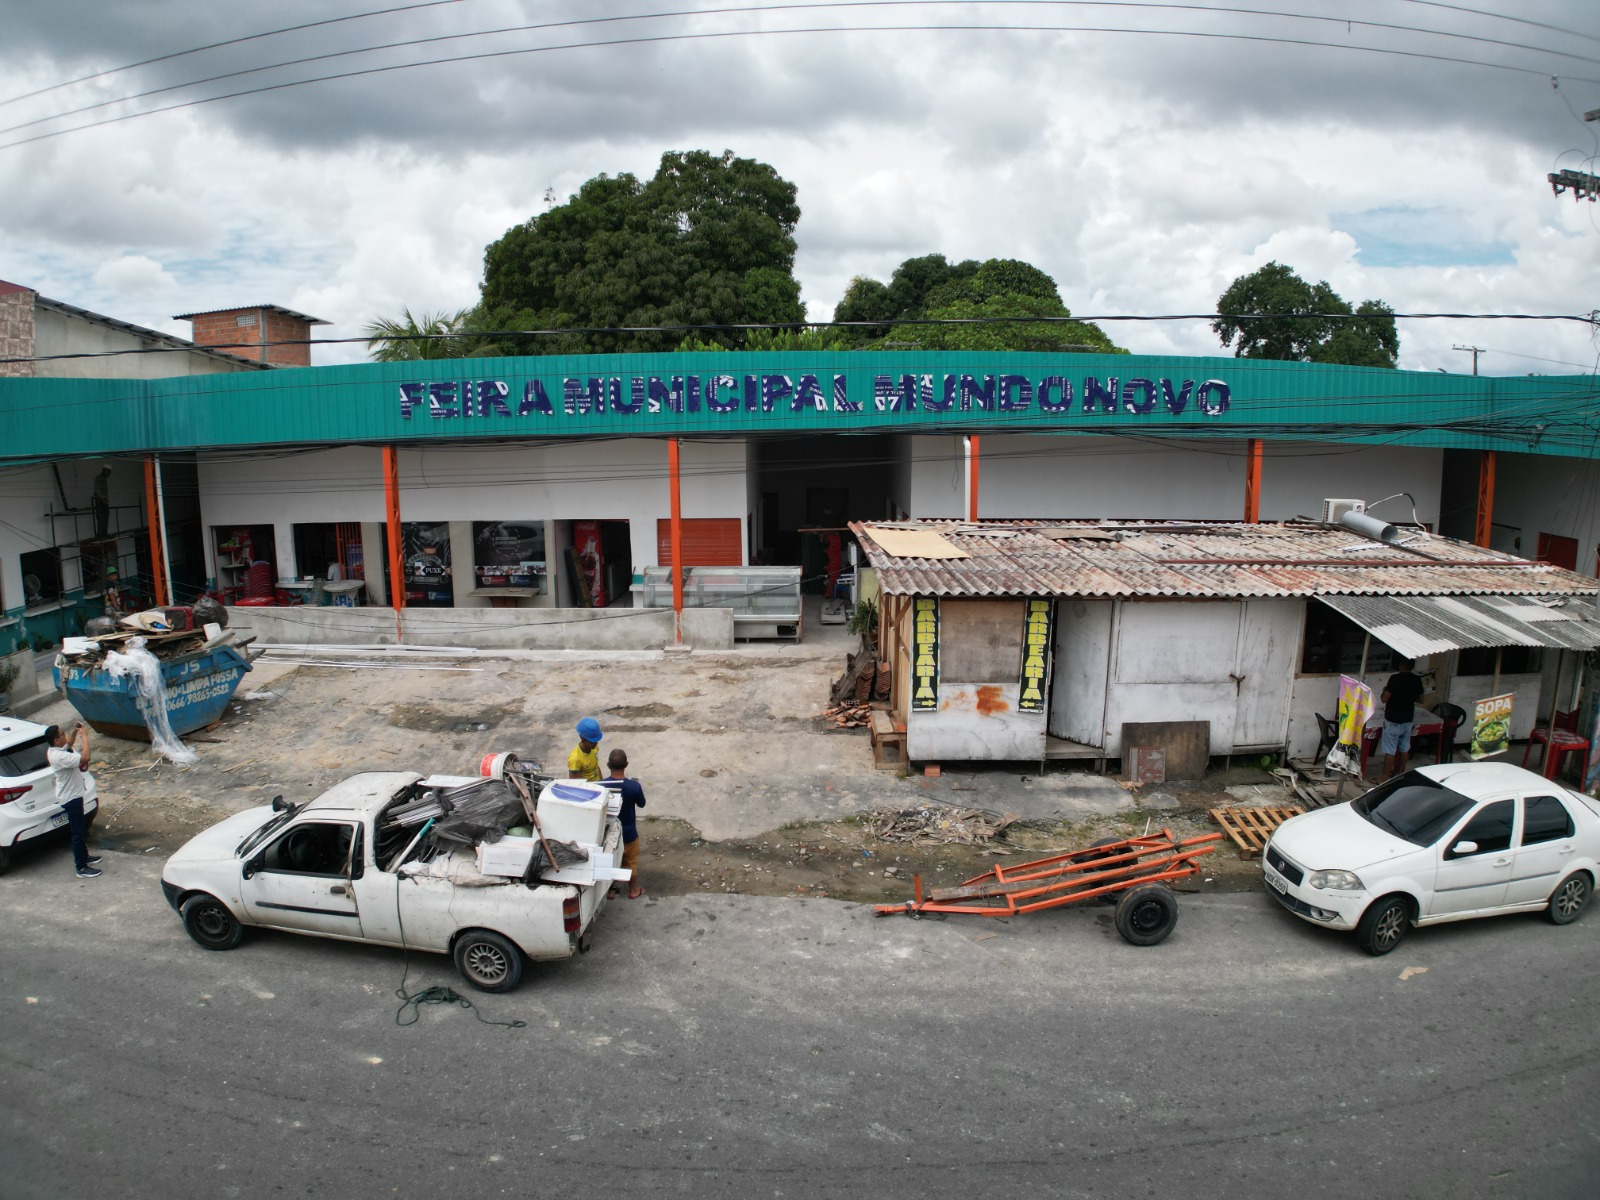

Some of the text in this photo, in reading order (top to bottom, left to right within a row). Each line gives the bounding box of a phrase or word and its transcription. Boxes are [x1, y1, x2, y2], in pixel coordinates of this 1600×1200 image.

[400, 374, 1231, 419] FEIRA MUNICIPAL MUNDO NOVO
[916, 599, 936, 698] BARBEARIA
[1022, 600, 1049, 700] BARBEARIA
[180, 660, 200, 675] JS
[181, 676, 210, 695] LIMPA
[210, 667, 238, 685] FOSSA
[1475, 697, 1512, 717] SOPA
